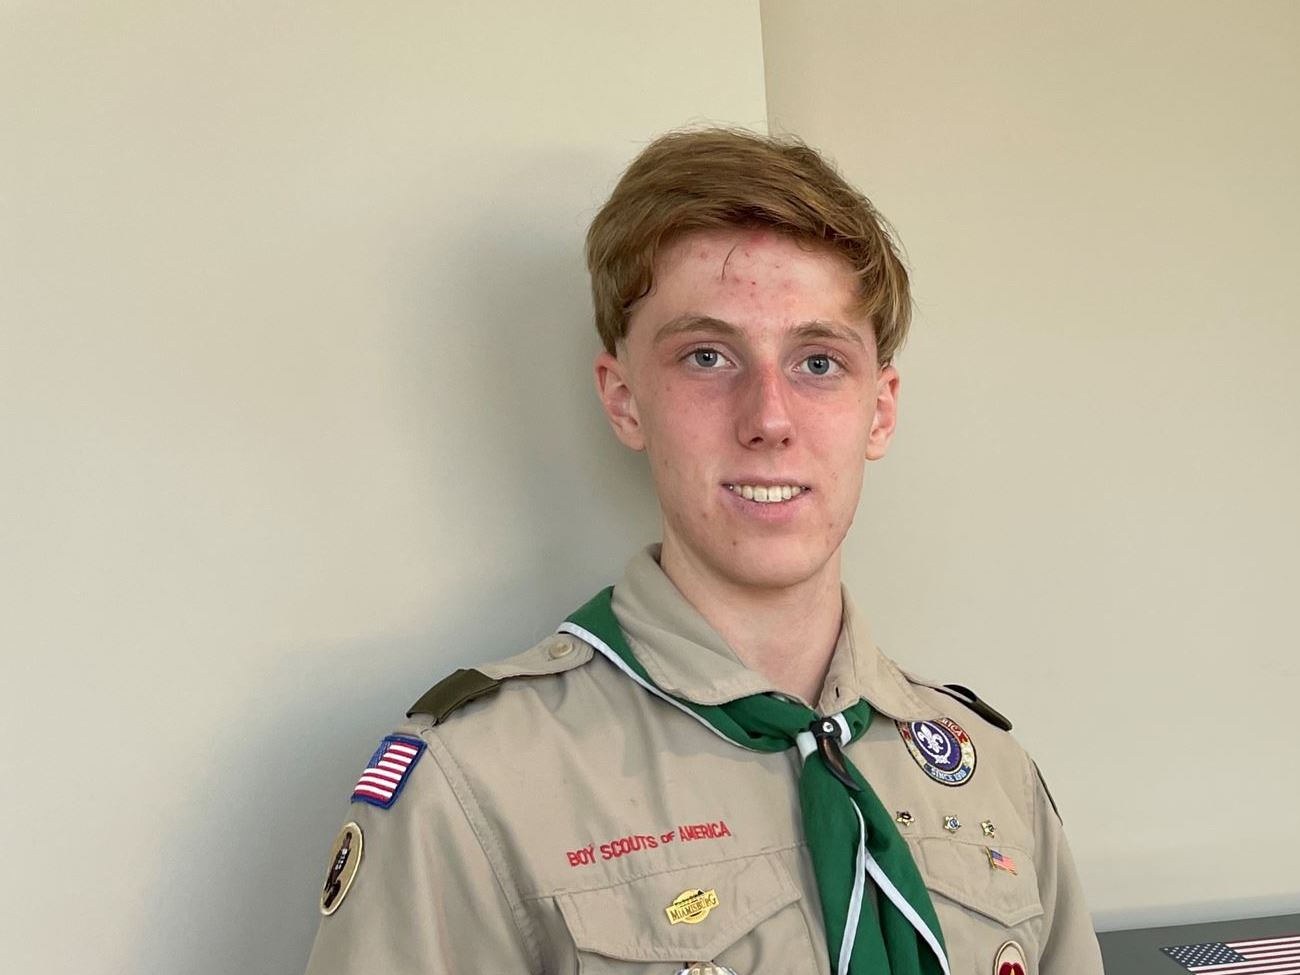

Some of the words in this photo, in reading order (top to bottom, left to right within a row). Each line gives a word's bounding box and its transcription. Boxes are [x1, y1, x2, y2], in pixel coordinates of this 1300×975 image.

[567, 844, 596, 867] BOY
[600, 835, 658, 860] SCOUTS
[678, 821, 731, 842] AMERICA
